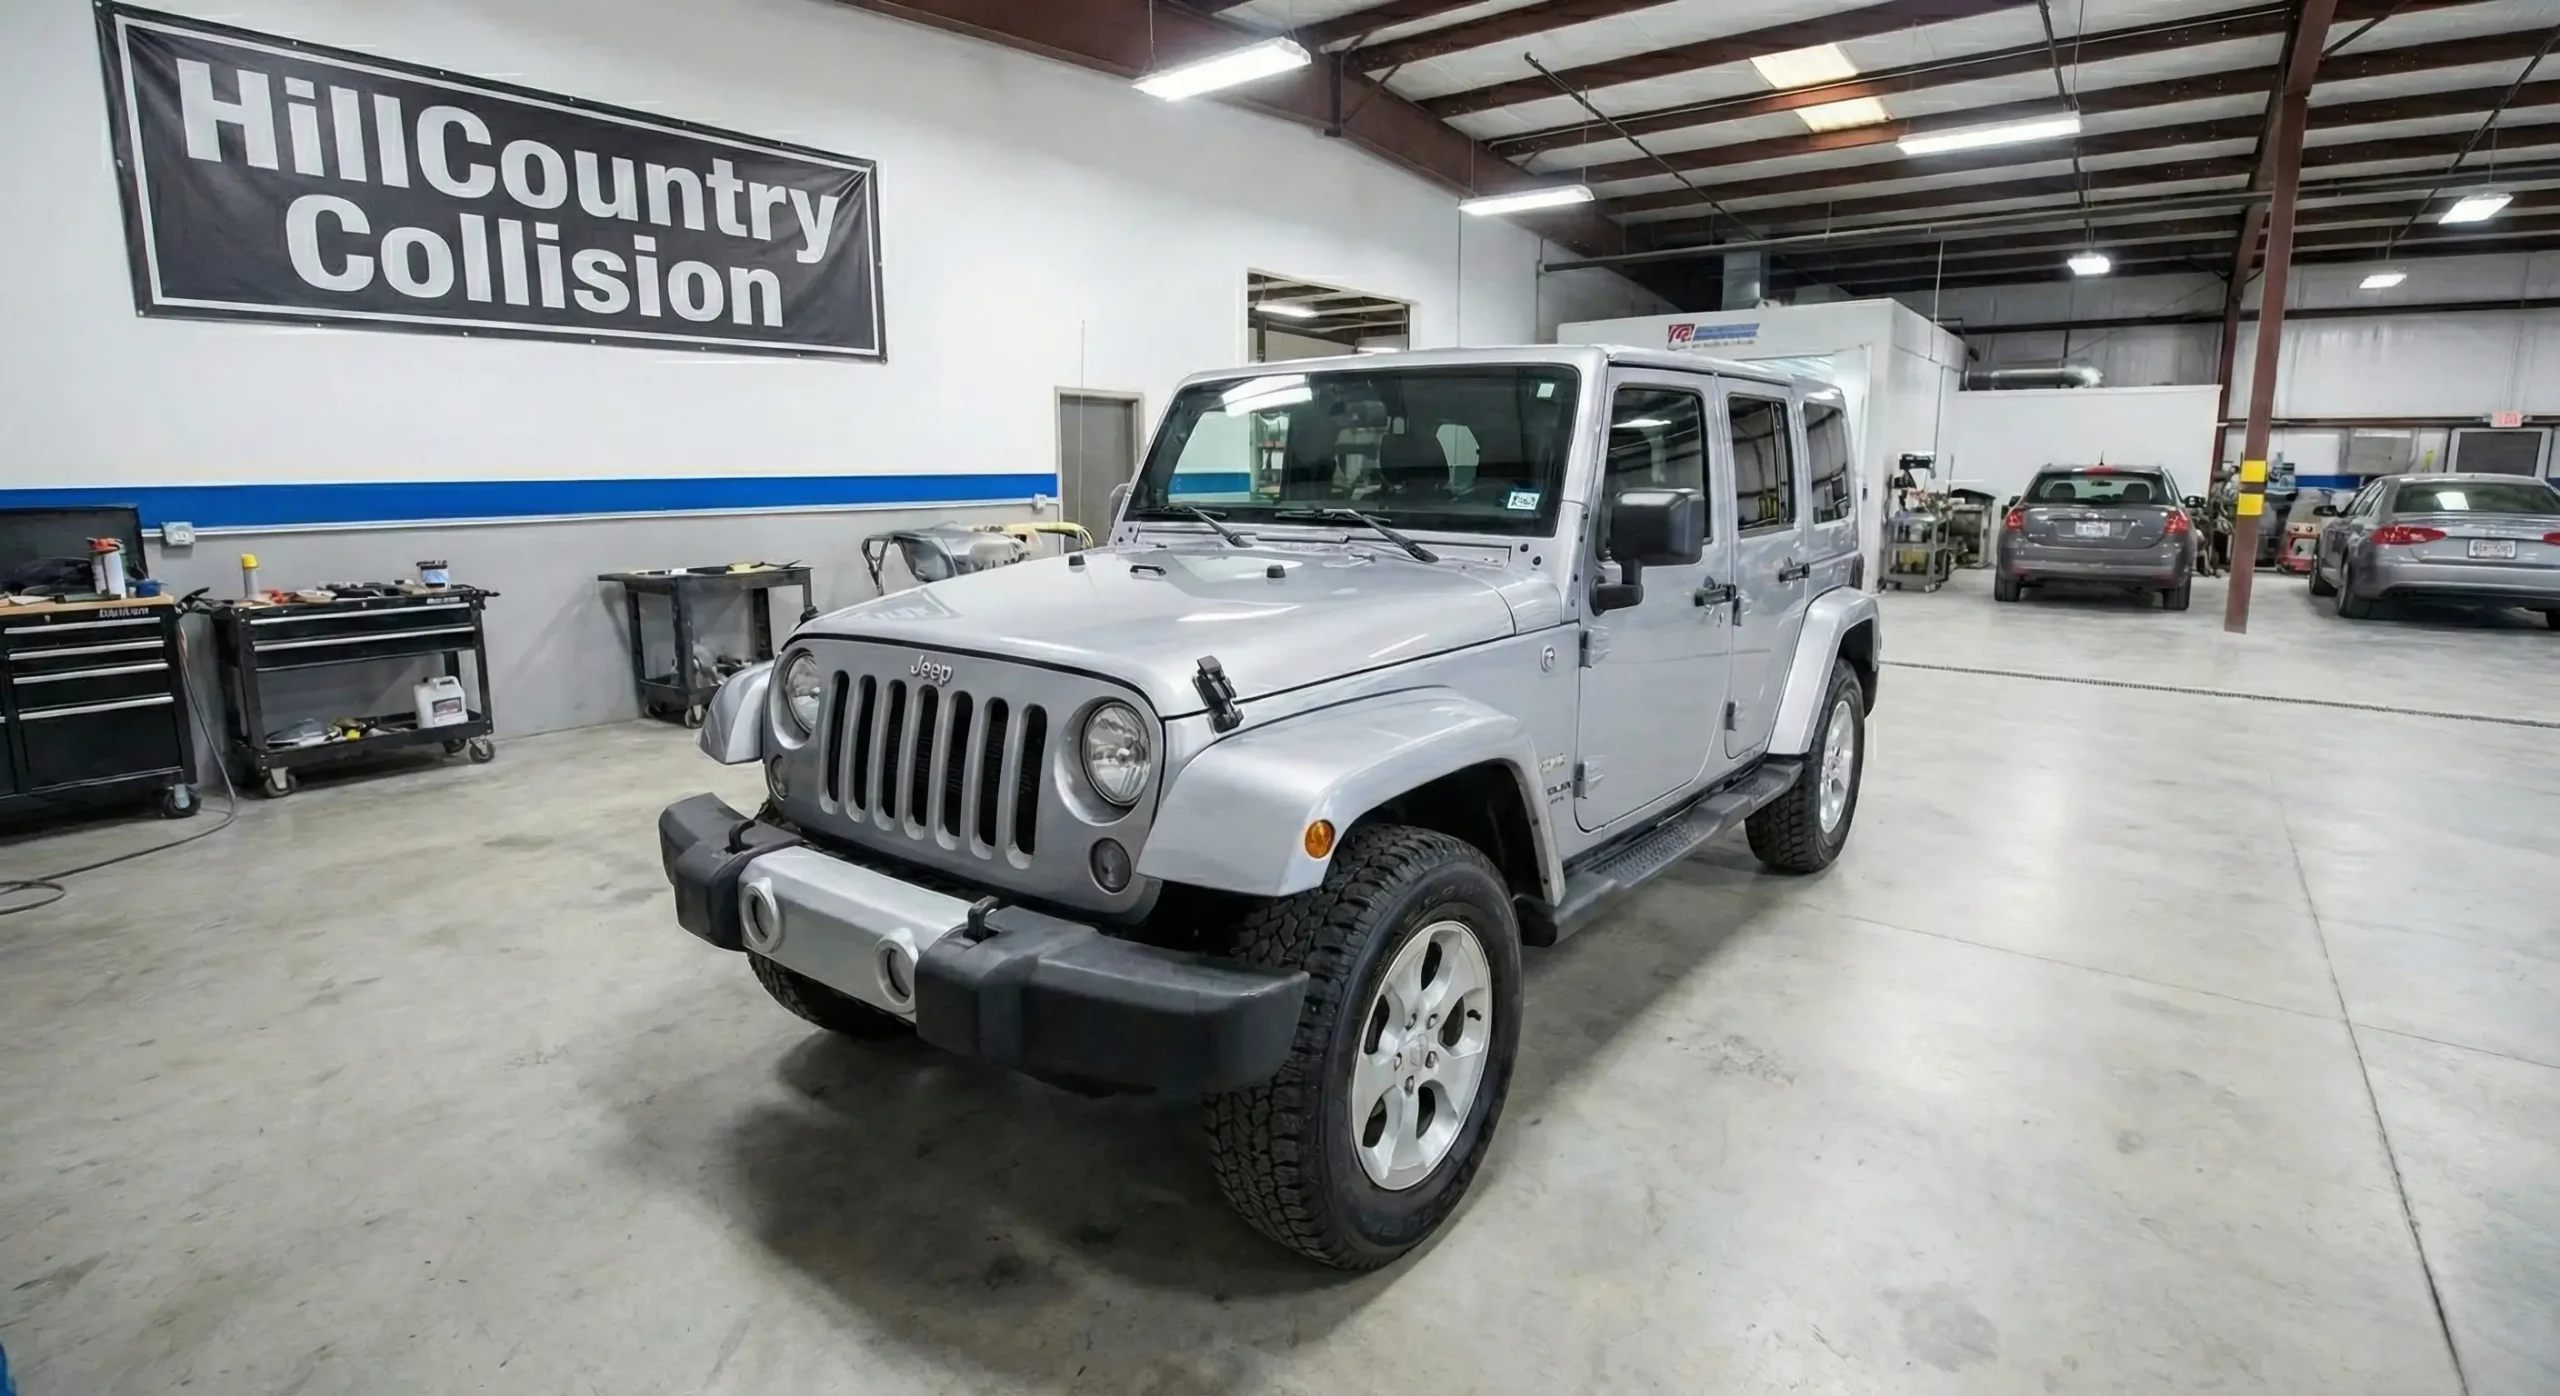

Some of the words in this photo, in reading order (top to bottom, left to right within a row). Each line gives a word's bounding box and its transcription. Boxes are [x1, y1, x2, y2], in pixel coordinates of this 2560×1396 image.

[176, 59, 839, 263] HillCountry
[286, 195, 784, 328] Collision
[910, 654, 952, 686] Jeep
